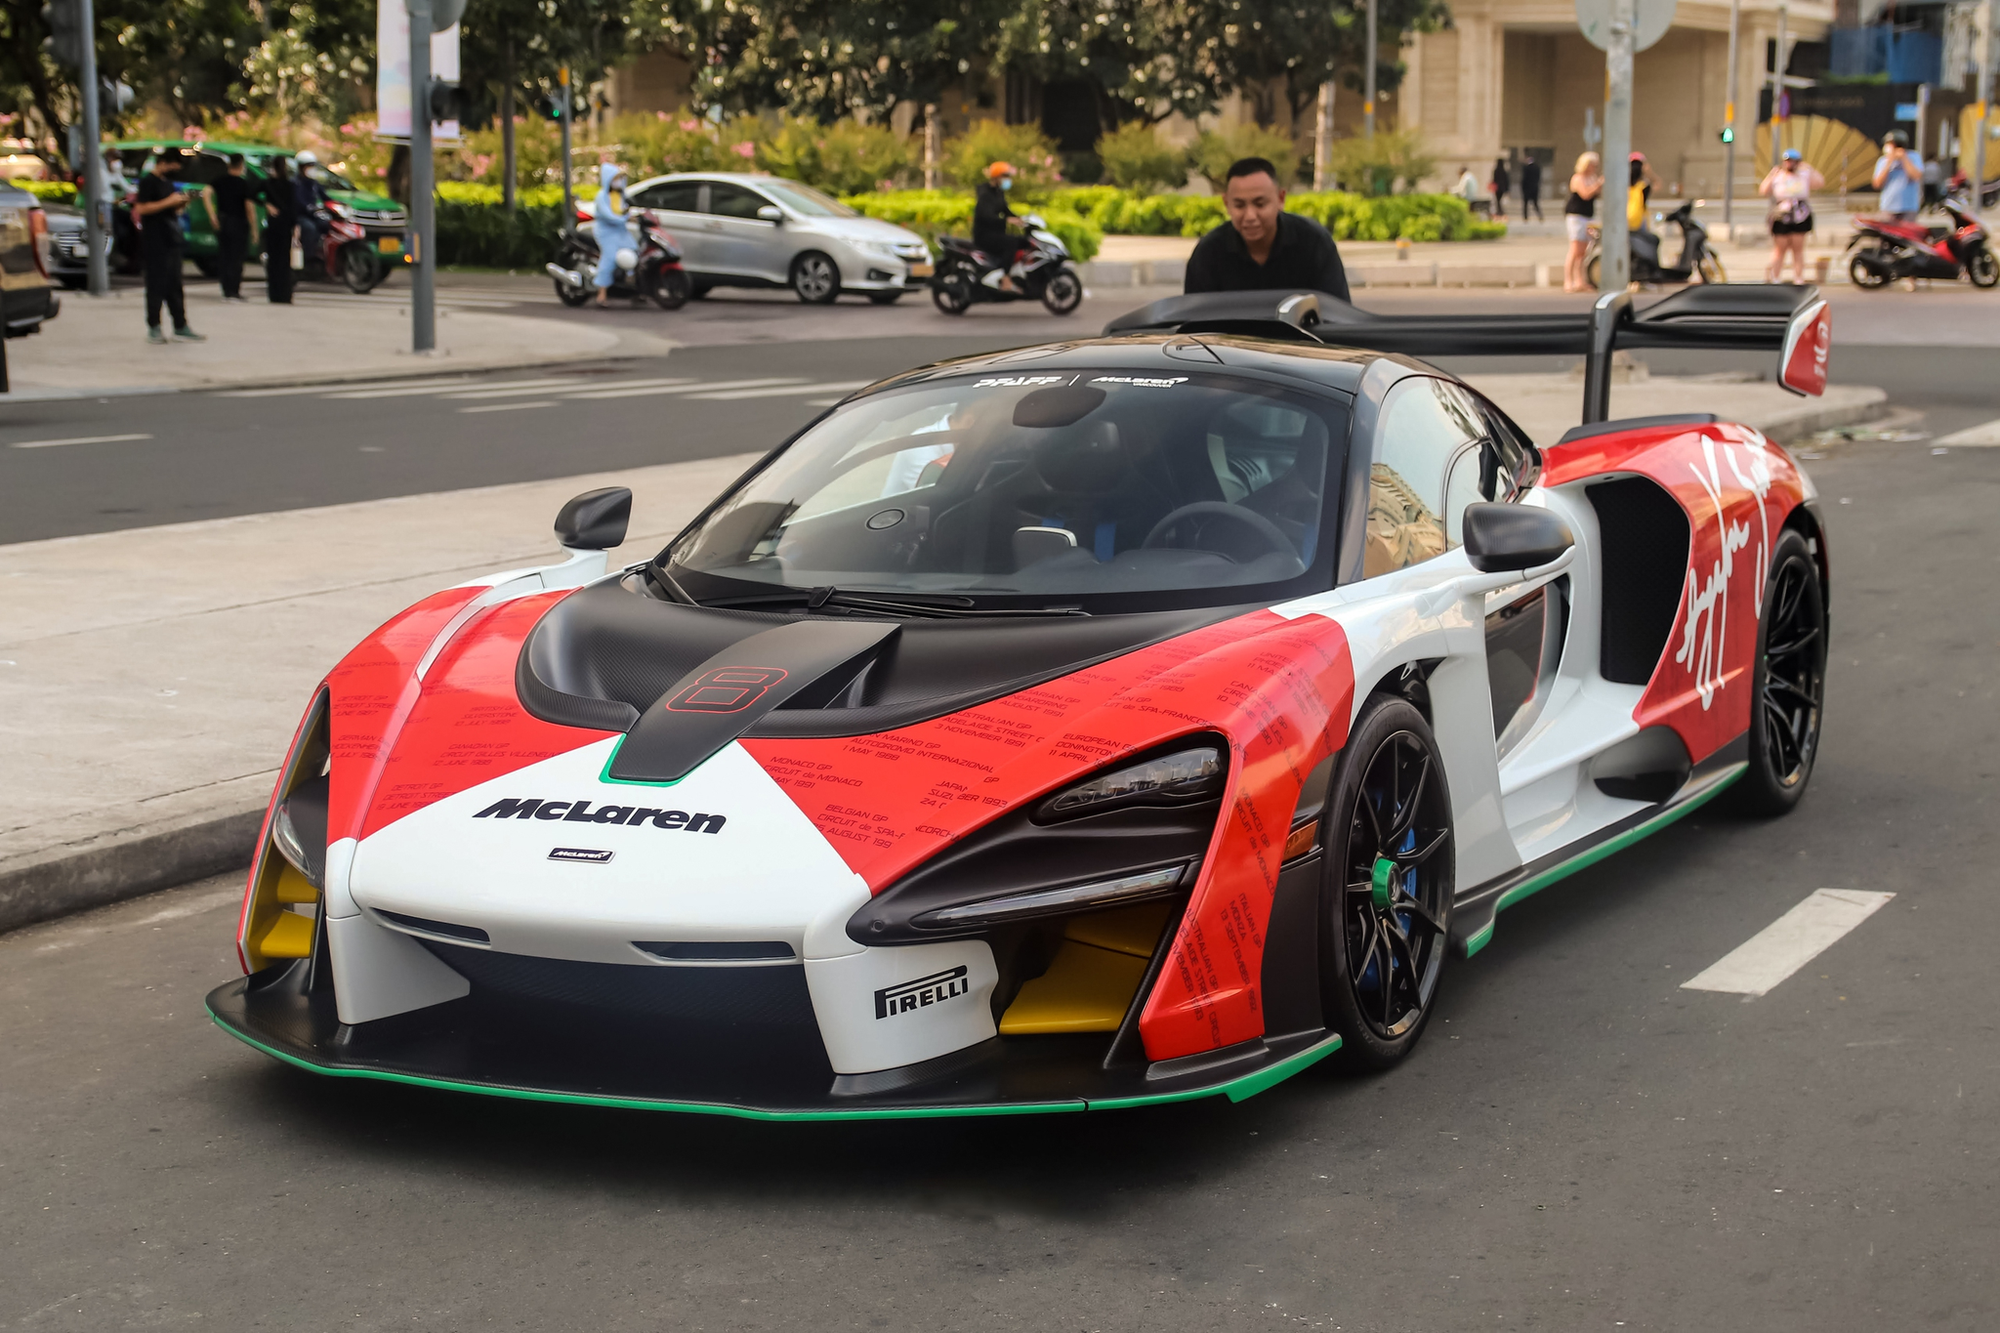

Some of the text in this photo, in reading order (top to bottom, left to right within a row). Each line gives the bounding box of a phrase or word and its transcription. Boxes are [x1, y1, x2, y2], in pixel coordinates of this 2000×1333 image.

[882, 733, 924, 747] MARINO
[944, 724, 1003, 742] NOVEMBER
[1003, 738, 1027, 749] 1991
[994, 726, 1035, 741] STREET
[1063, 732, 1121, 748] EUROPEAN
[848, 746, 873, 755] MAY
[850, 738, 916, 755] AUTODROMO
[770, 756, 833, 771] MONACO GP
[1057, 751, 1089, 763] APRIL
[763, 764, 863, 788] CIRCUIT de MONACO
[793, 779, 816, 790] 1991
[473, 798, 728, 834] McLaren
[825, 803, 889, 822] BELGIAN GP
[817, 813, 859, 828] CIRCUIT
[858, 823, 872, 831] de
[826, 827, 871, 843] AUGUST
[1229, 900, 1247, 941] MONZA
[1238, 892, 1257, 933] ITALIAN
[1224, 922, 1251, 986] SEPTEMBER
[1208, 974, 1219, 990] GP
[874, 965, 969, 1020] PIRELLI
